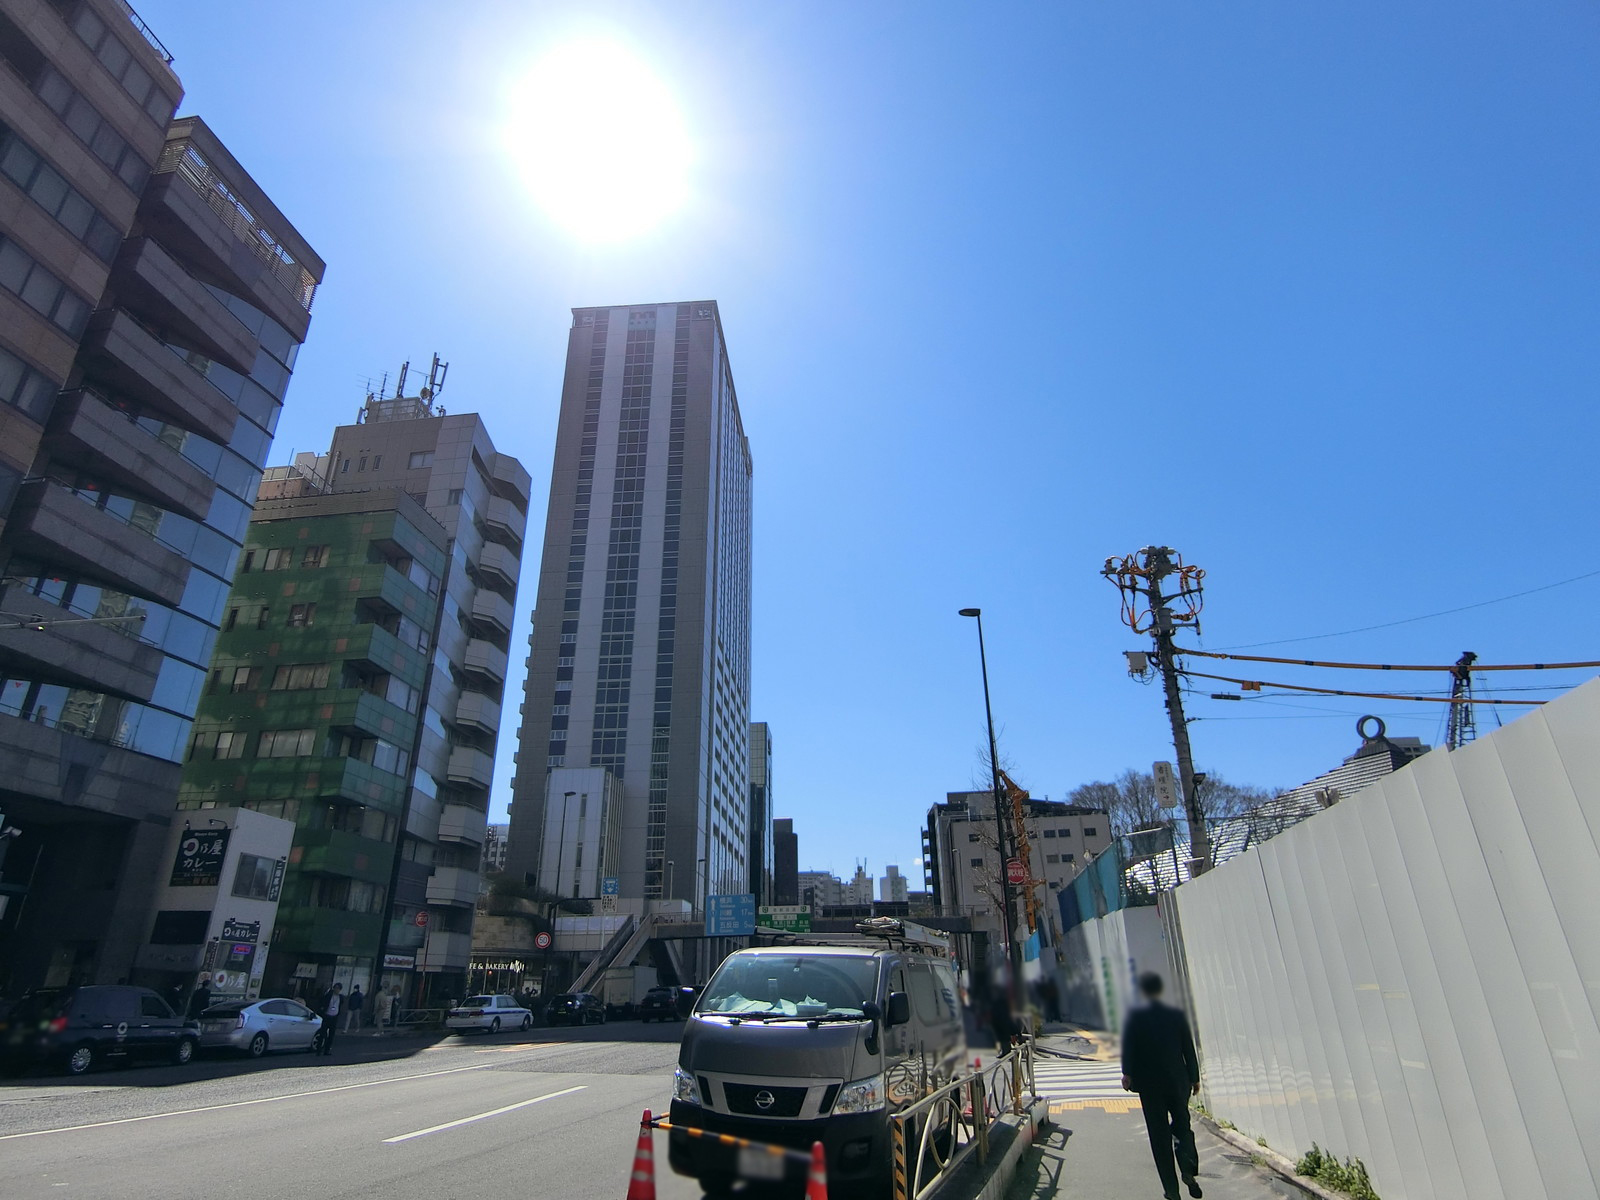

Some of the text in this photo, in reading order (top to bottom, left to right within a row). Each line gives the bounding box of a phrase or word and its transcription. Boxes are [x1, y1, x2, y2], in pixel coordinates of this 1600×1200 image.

[183, 858, 218, 868] カレー
[540, 936, 548, 944] 50
[485, 962, 510, 970] BAKERY
